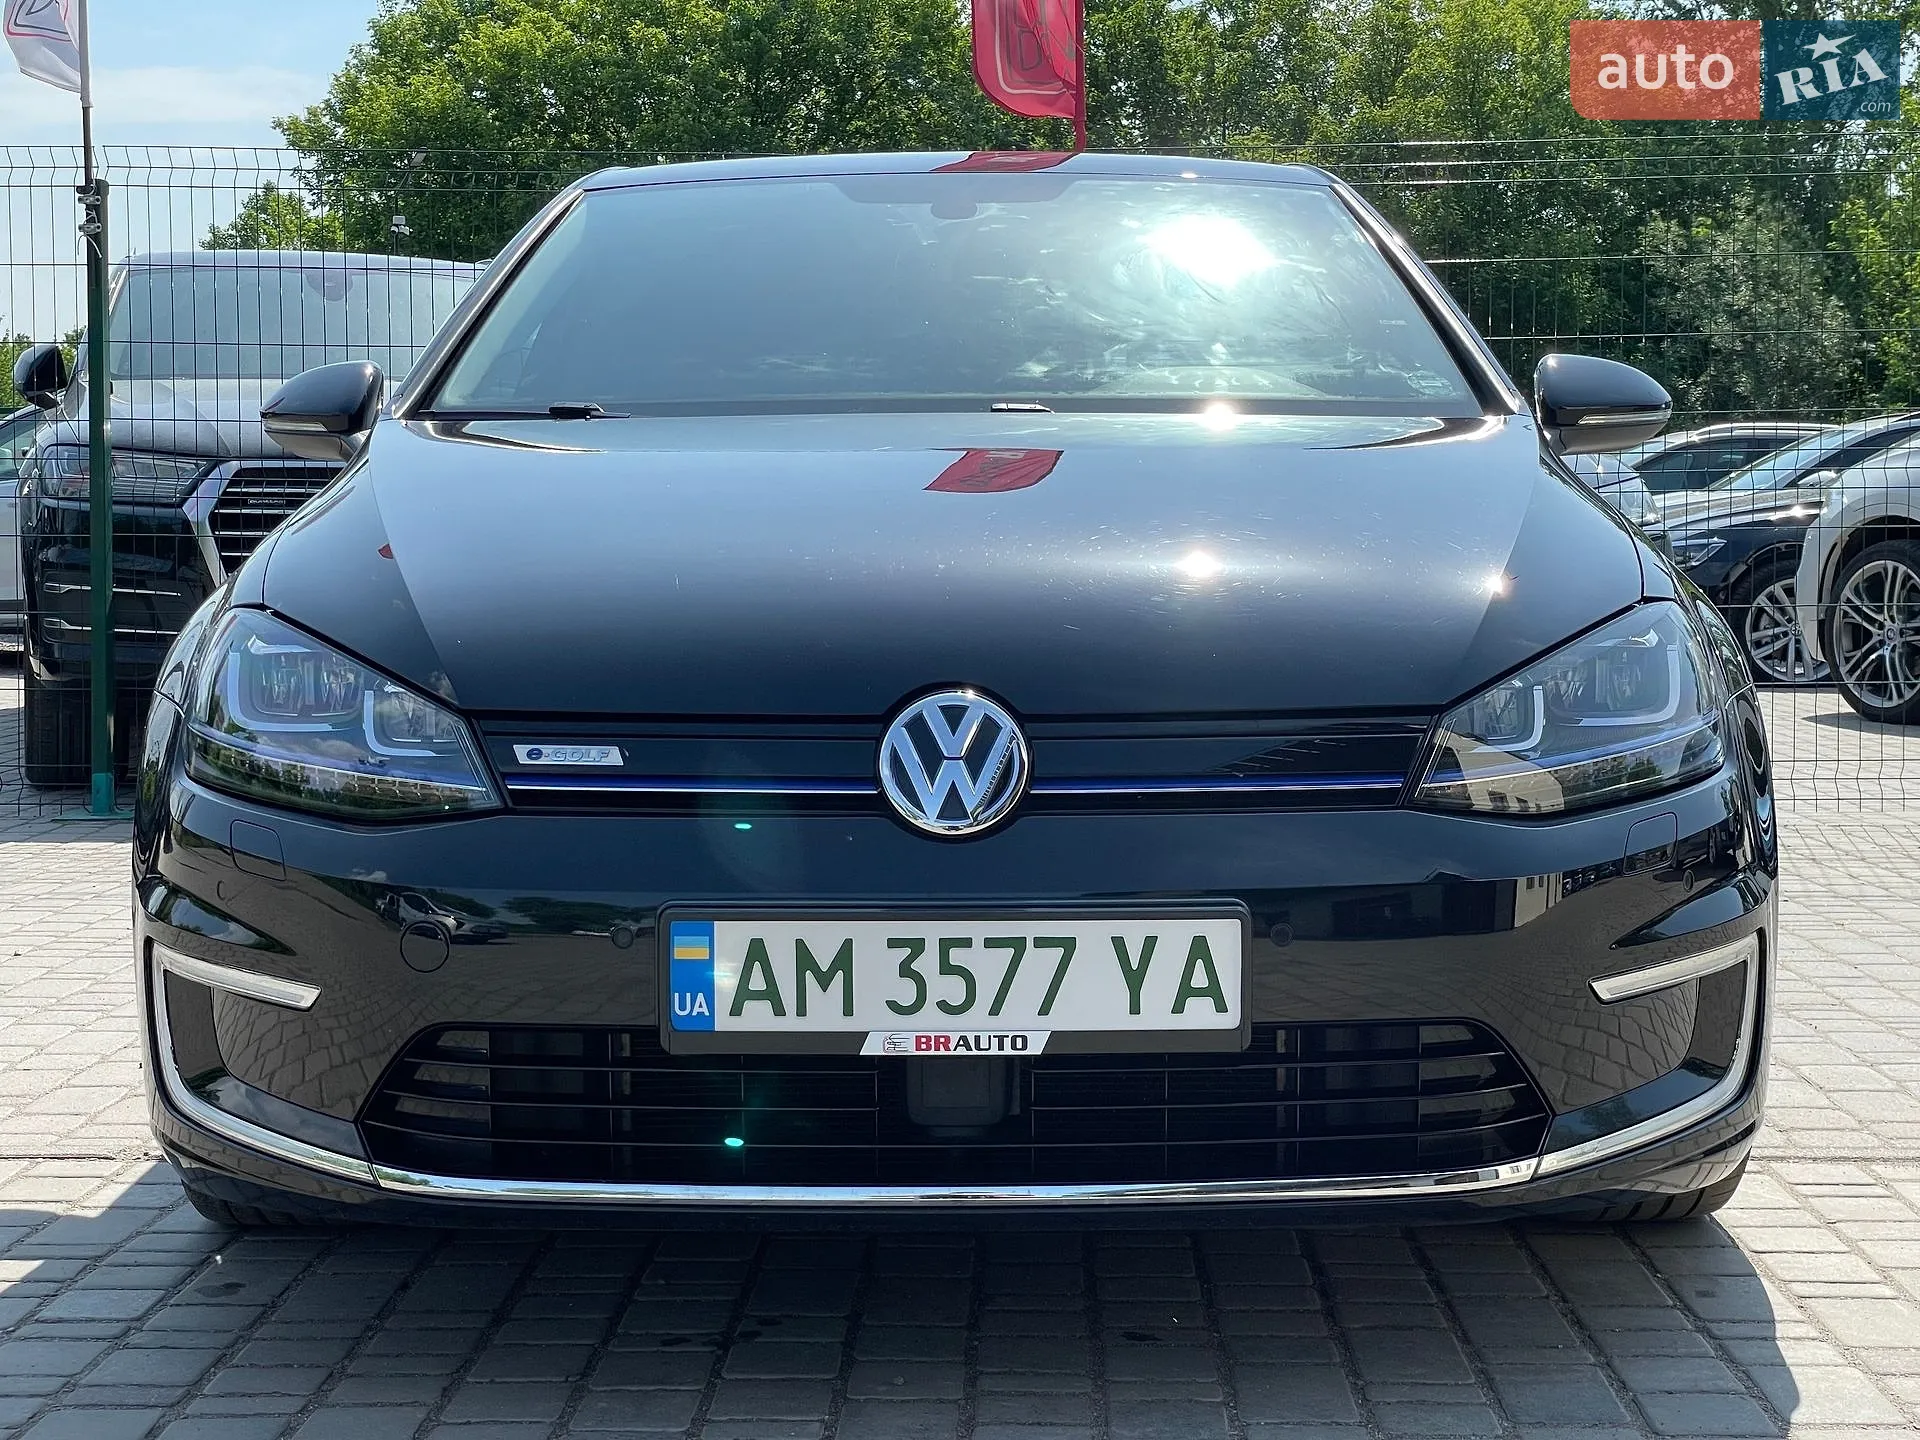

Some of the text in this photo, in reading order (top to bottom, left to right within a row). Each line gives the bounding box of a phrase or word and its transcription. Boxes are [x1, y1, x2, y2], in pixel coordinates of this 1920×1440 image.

[728, 935, 1229, 1017] AM 3577 YA
[674, 993, 710, 1017] UA
[914, 1034, 1029, 1052] BRAUTO
